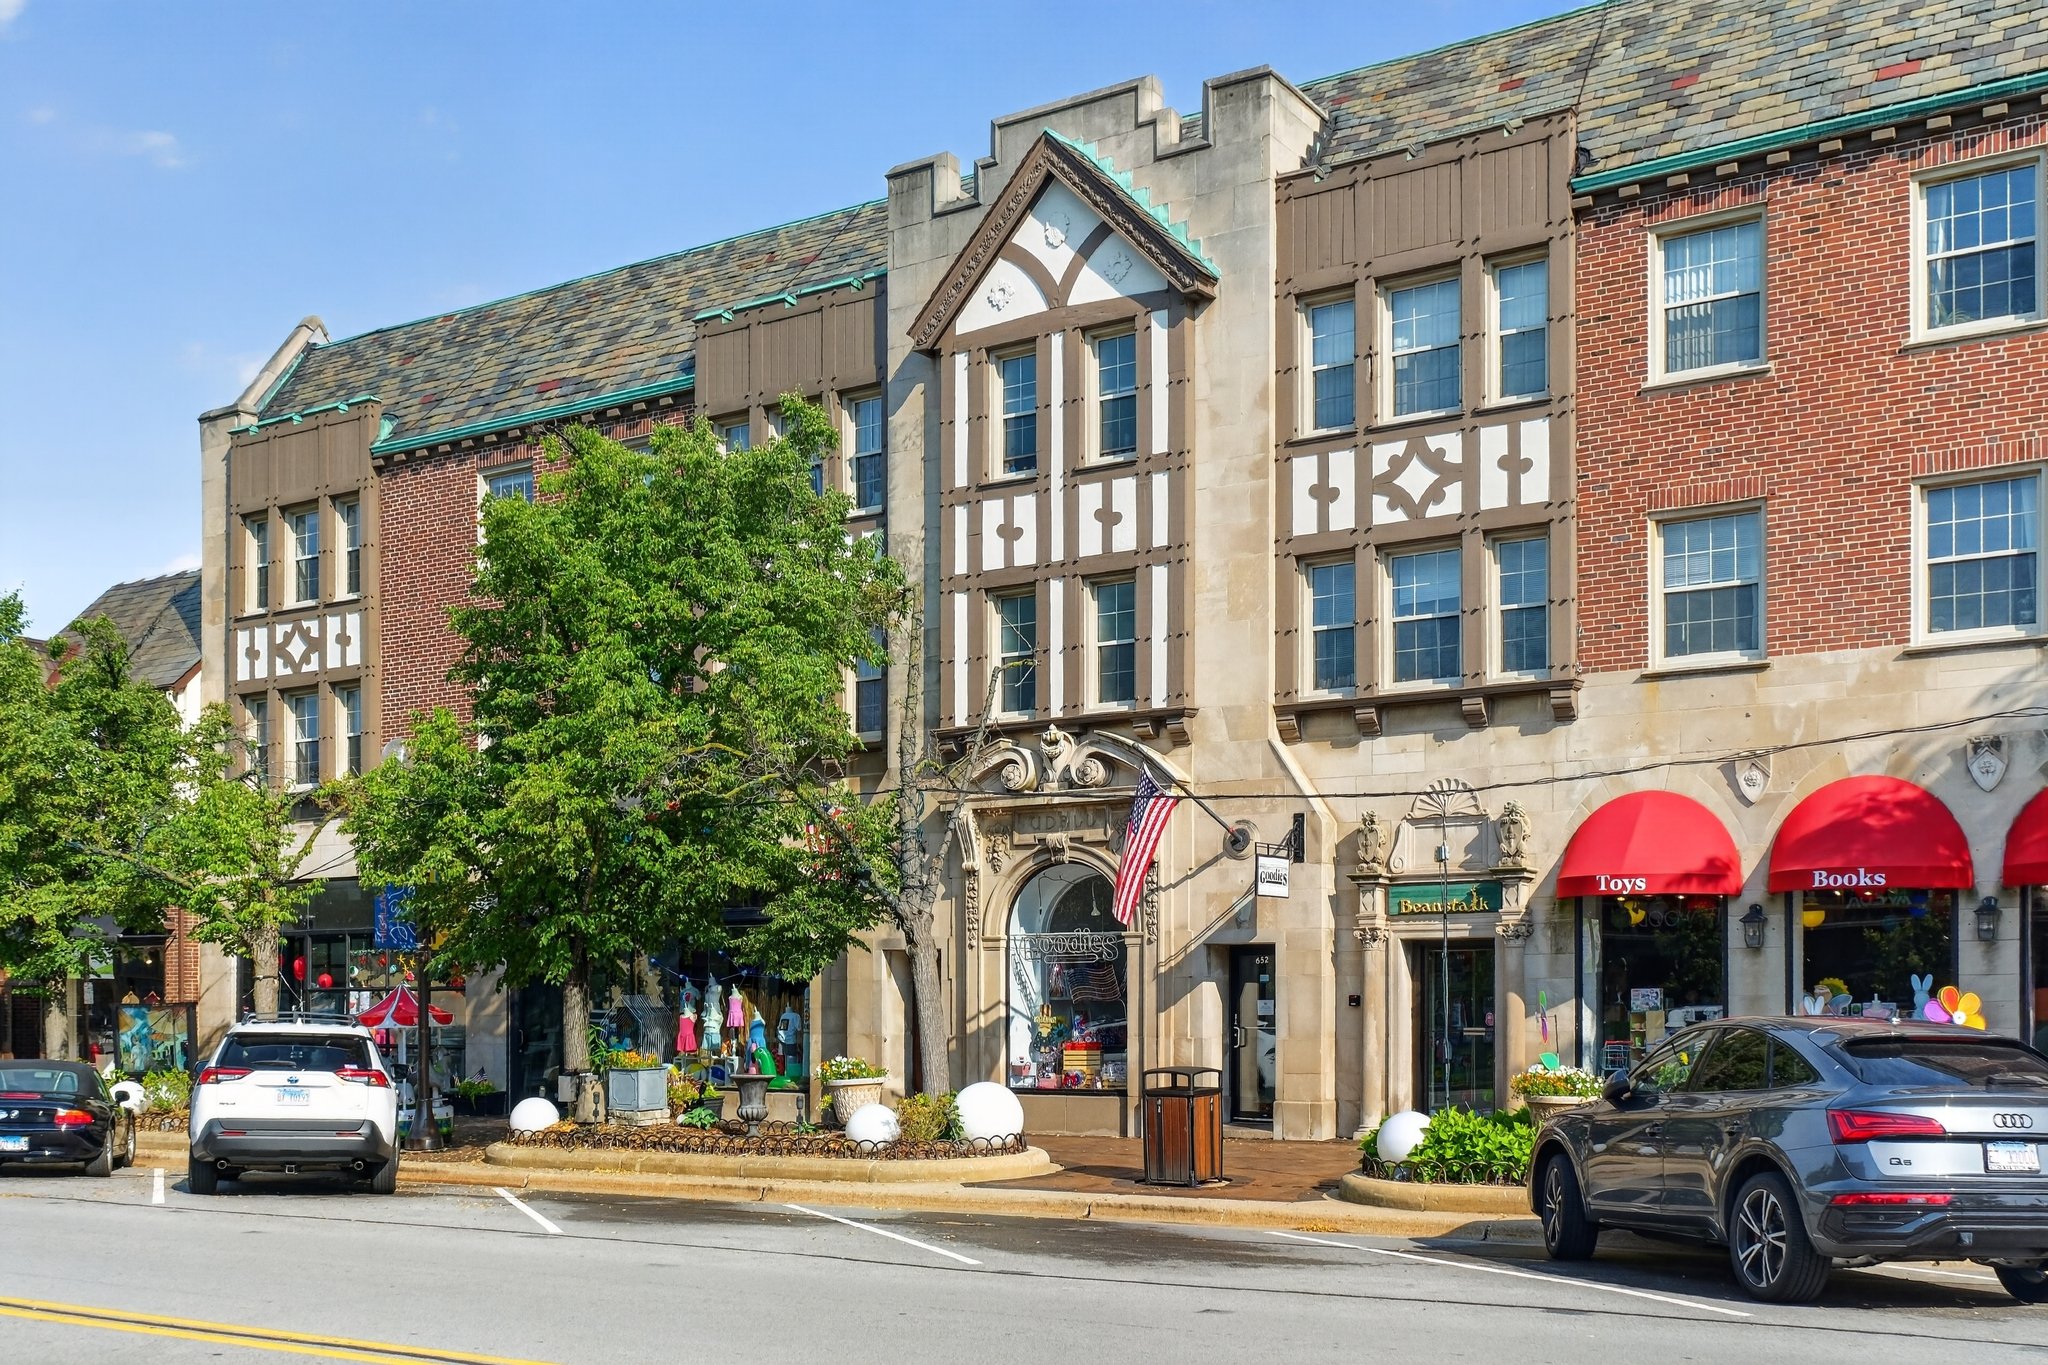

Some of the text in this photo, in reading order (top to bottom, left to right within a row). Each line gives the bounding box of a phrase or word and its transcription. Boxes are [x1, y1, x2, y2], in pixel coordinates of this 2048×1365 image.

[1260, 868, 1287, 886] Goodies
[1596, 875, 1646, 894] Toys
[1812, 868, 1886, 887] Books
[1399, 886, 1489, 913] Beanstalk
[1022, 928, 1119, 962] Goodies
[1255, 956, 1269, 965] 652
[1889, 1157, 1912, 1166] Q5
